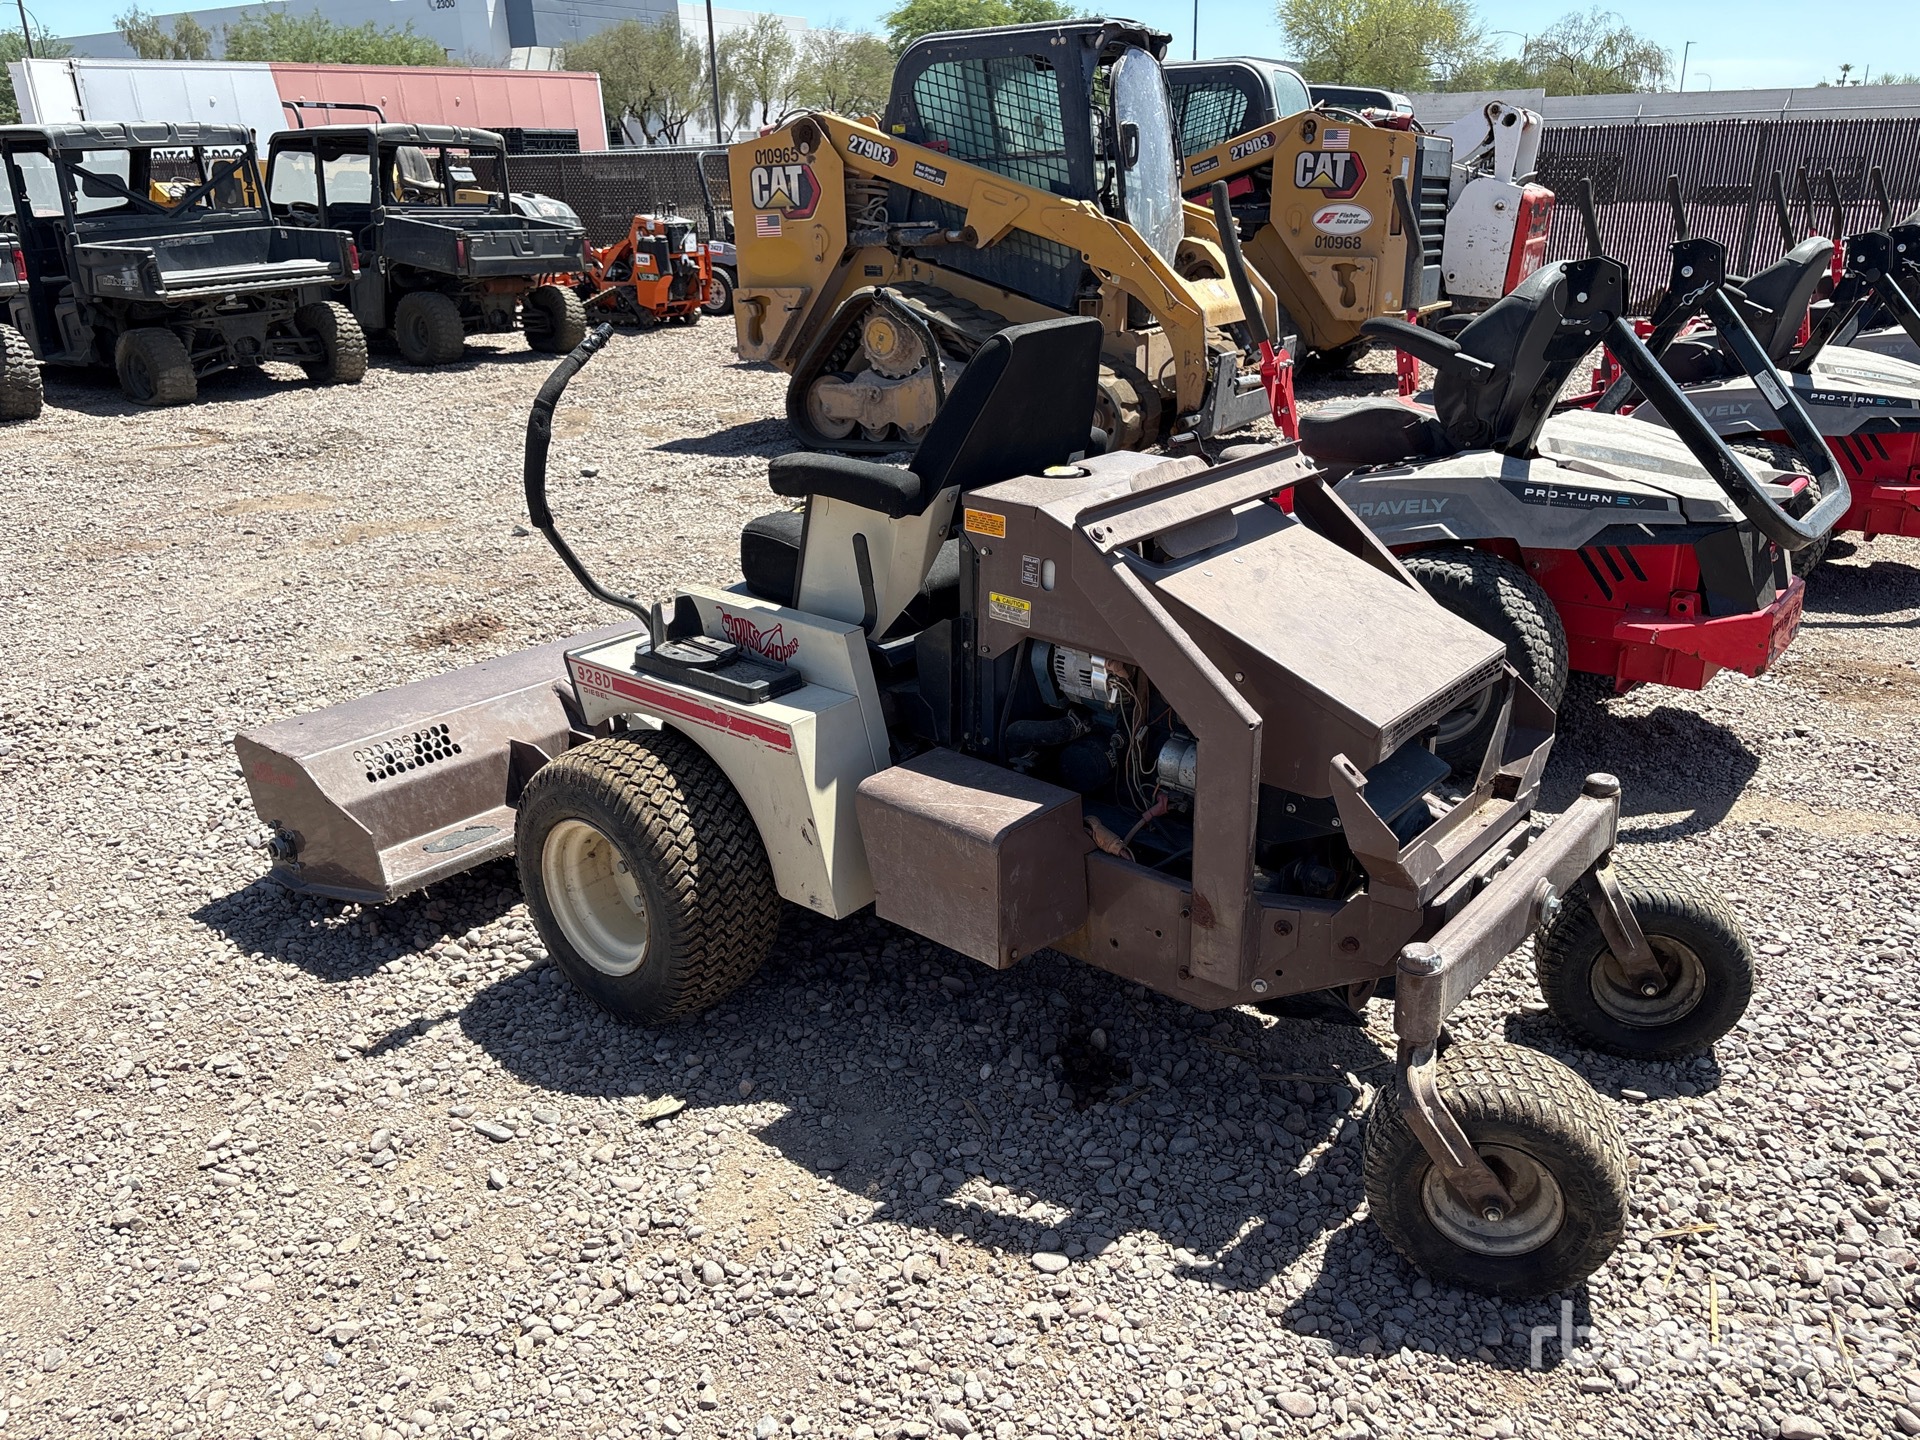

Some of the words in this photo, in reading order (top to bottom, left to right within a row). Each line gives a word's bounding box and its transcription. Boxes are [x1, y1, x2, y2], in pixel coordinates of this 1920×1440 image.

[848, 134, 891, 165] 279D3
[1230, 134, 1270, 161] 279D3
[755, 148, 799, 165] 010965
[1295, 152, 1350, 188] CAT
[752, 165, 803, 209] CAT
[1315, 235, 1362, 250] 010968
[1810, 393, 1874, 404] PRO-TURN
[1524, 488, 1612, 504] PRO-TURN
[1002, 597, 1025, 609] CAUTION
[577, 666, 611, 688] 928D
[583, 687, 610, 700] DIESEL
